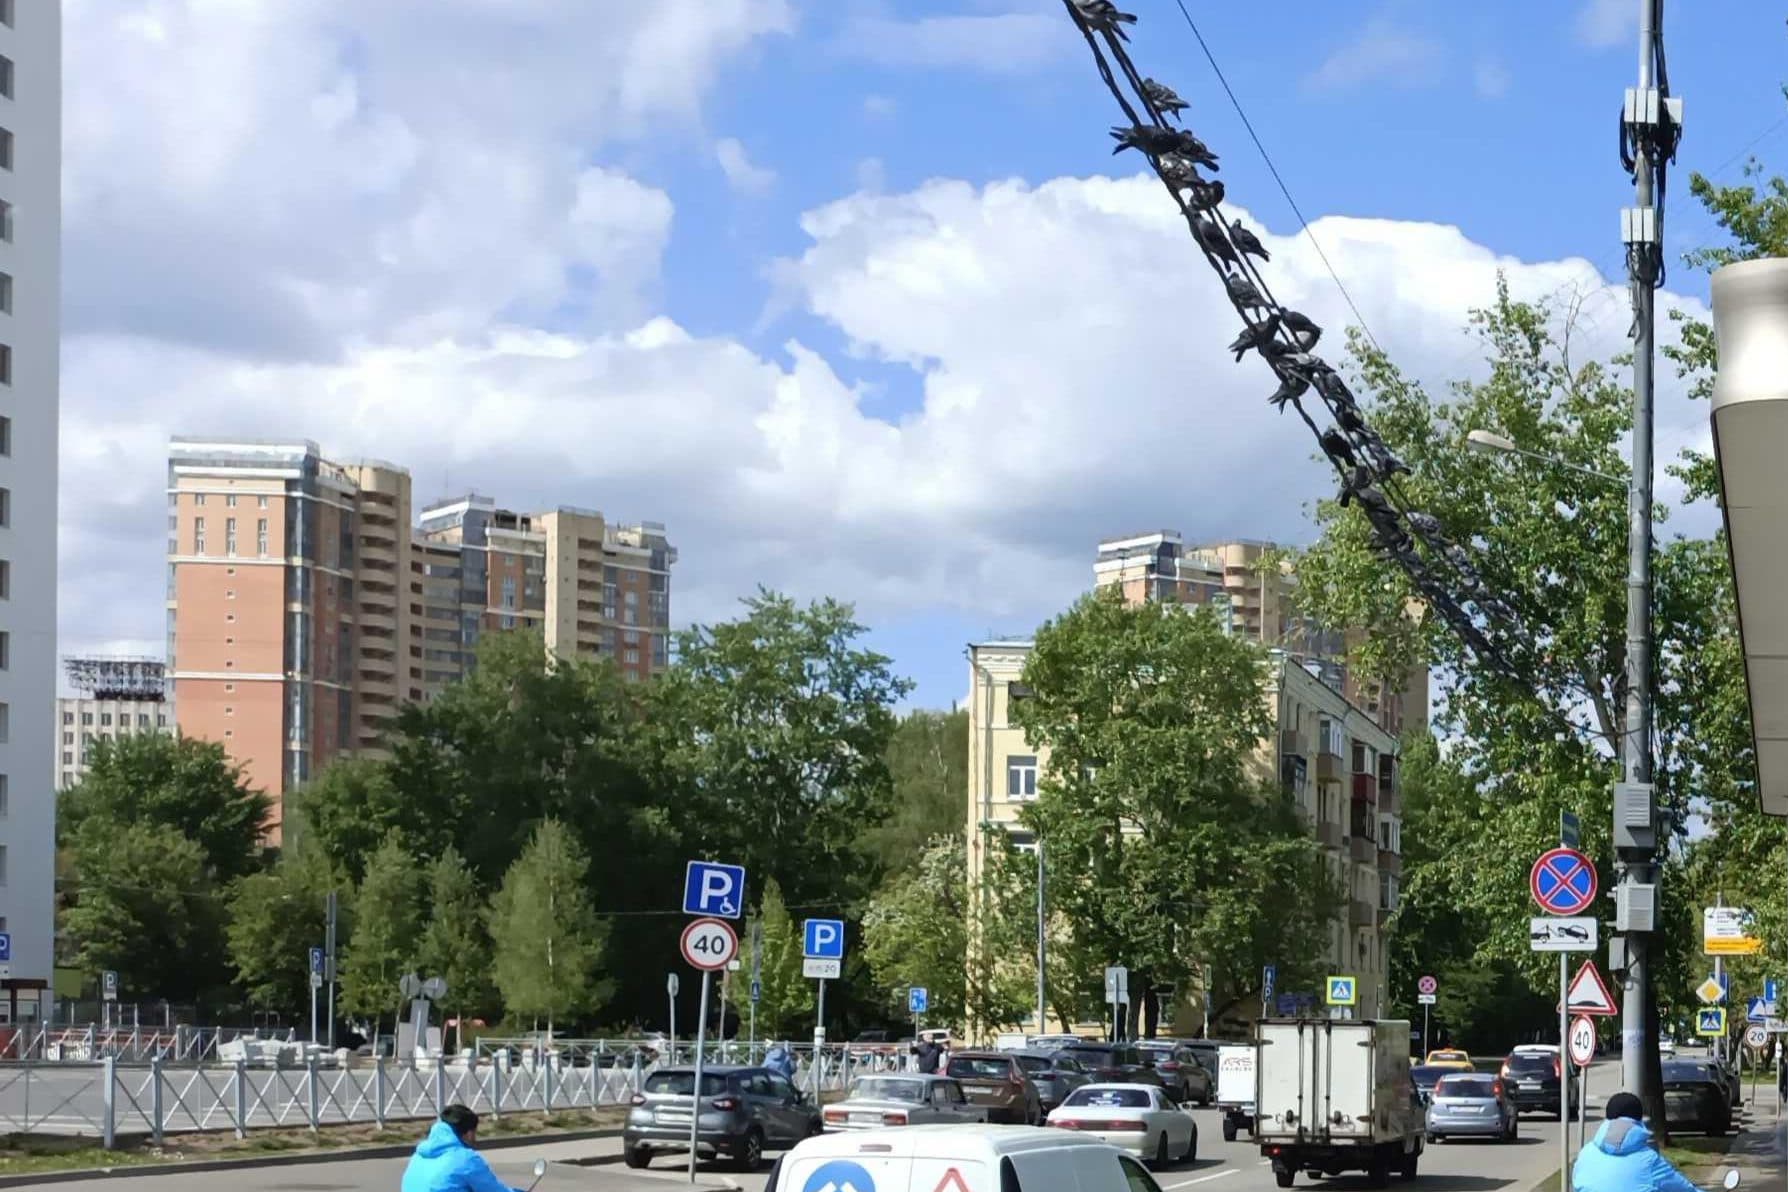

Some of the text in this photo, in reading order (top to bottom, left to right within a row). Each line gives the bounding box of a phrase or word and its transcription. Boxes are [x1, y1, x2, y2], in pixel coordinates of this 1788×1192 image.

[700, 870, 733, 909] P
[694, 935, 725, 955] 40
[815, 924, 836, 953] P
[1575, 1031, 1590, 1049] 40
